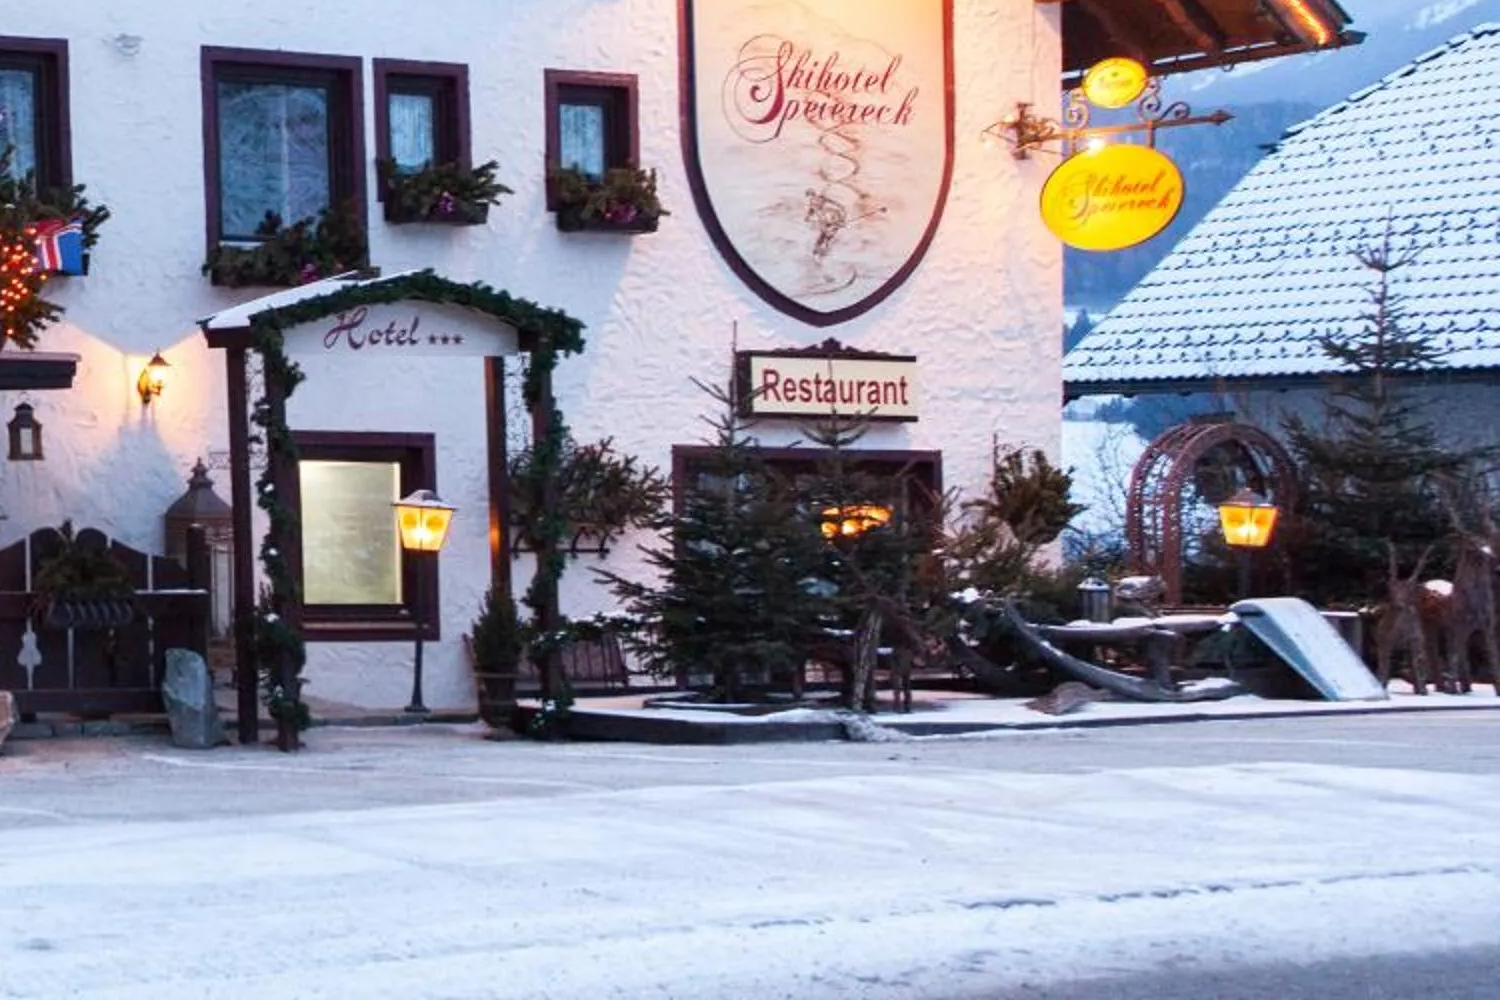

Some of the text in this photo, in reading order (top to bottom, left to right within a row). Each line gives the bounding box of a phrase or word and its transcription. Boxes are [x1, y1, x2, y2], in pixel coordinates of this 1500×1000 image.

[732, 34, 902, 125] Skihotel
[323, 306, 421, 350] Hotel
[762, 368, 909, 406] Restaurant
